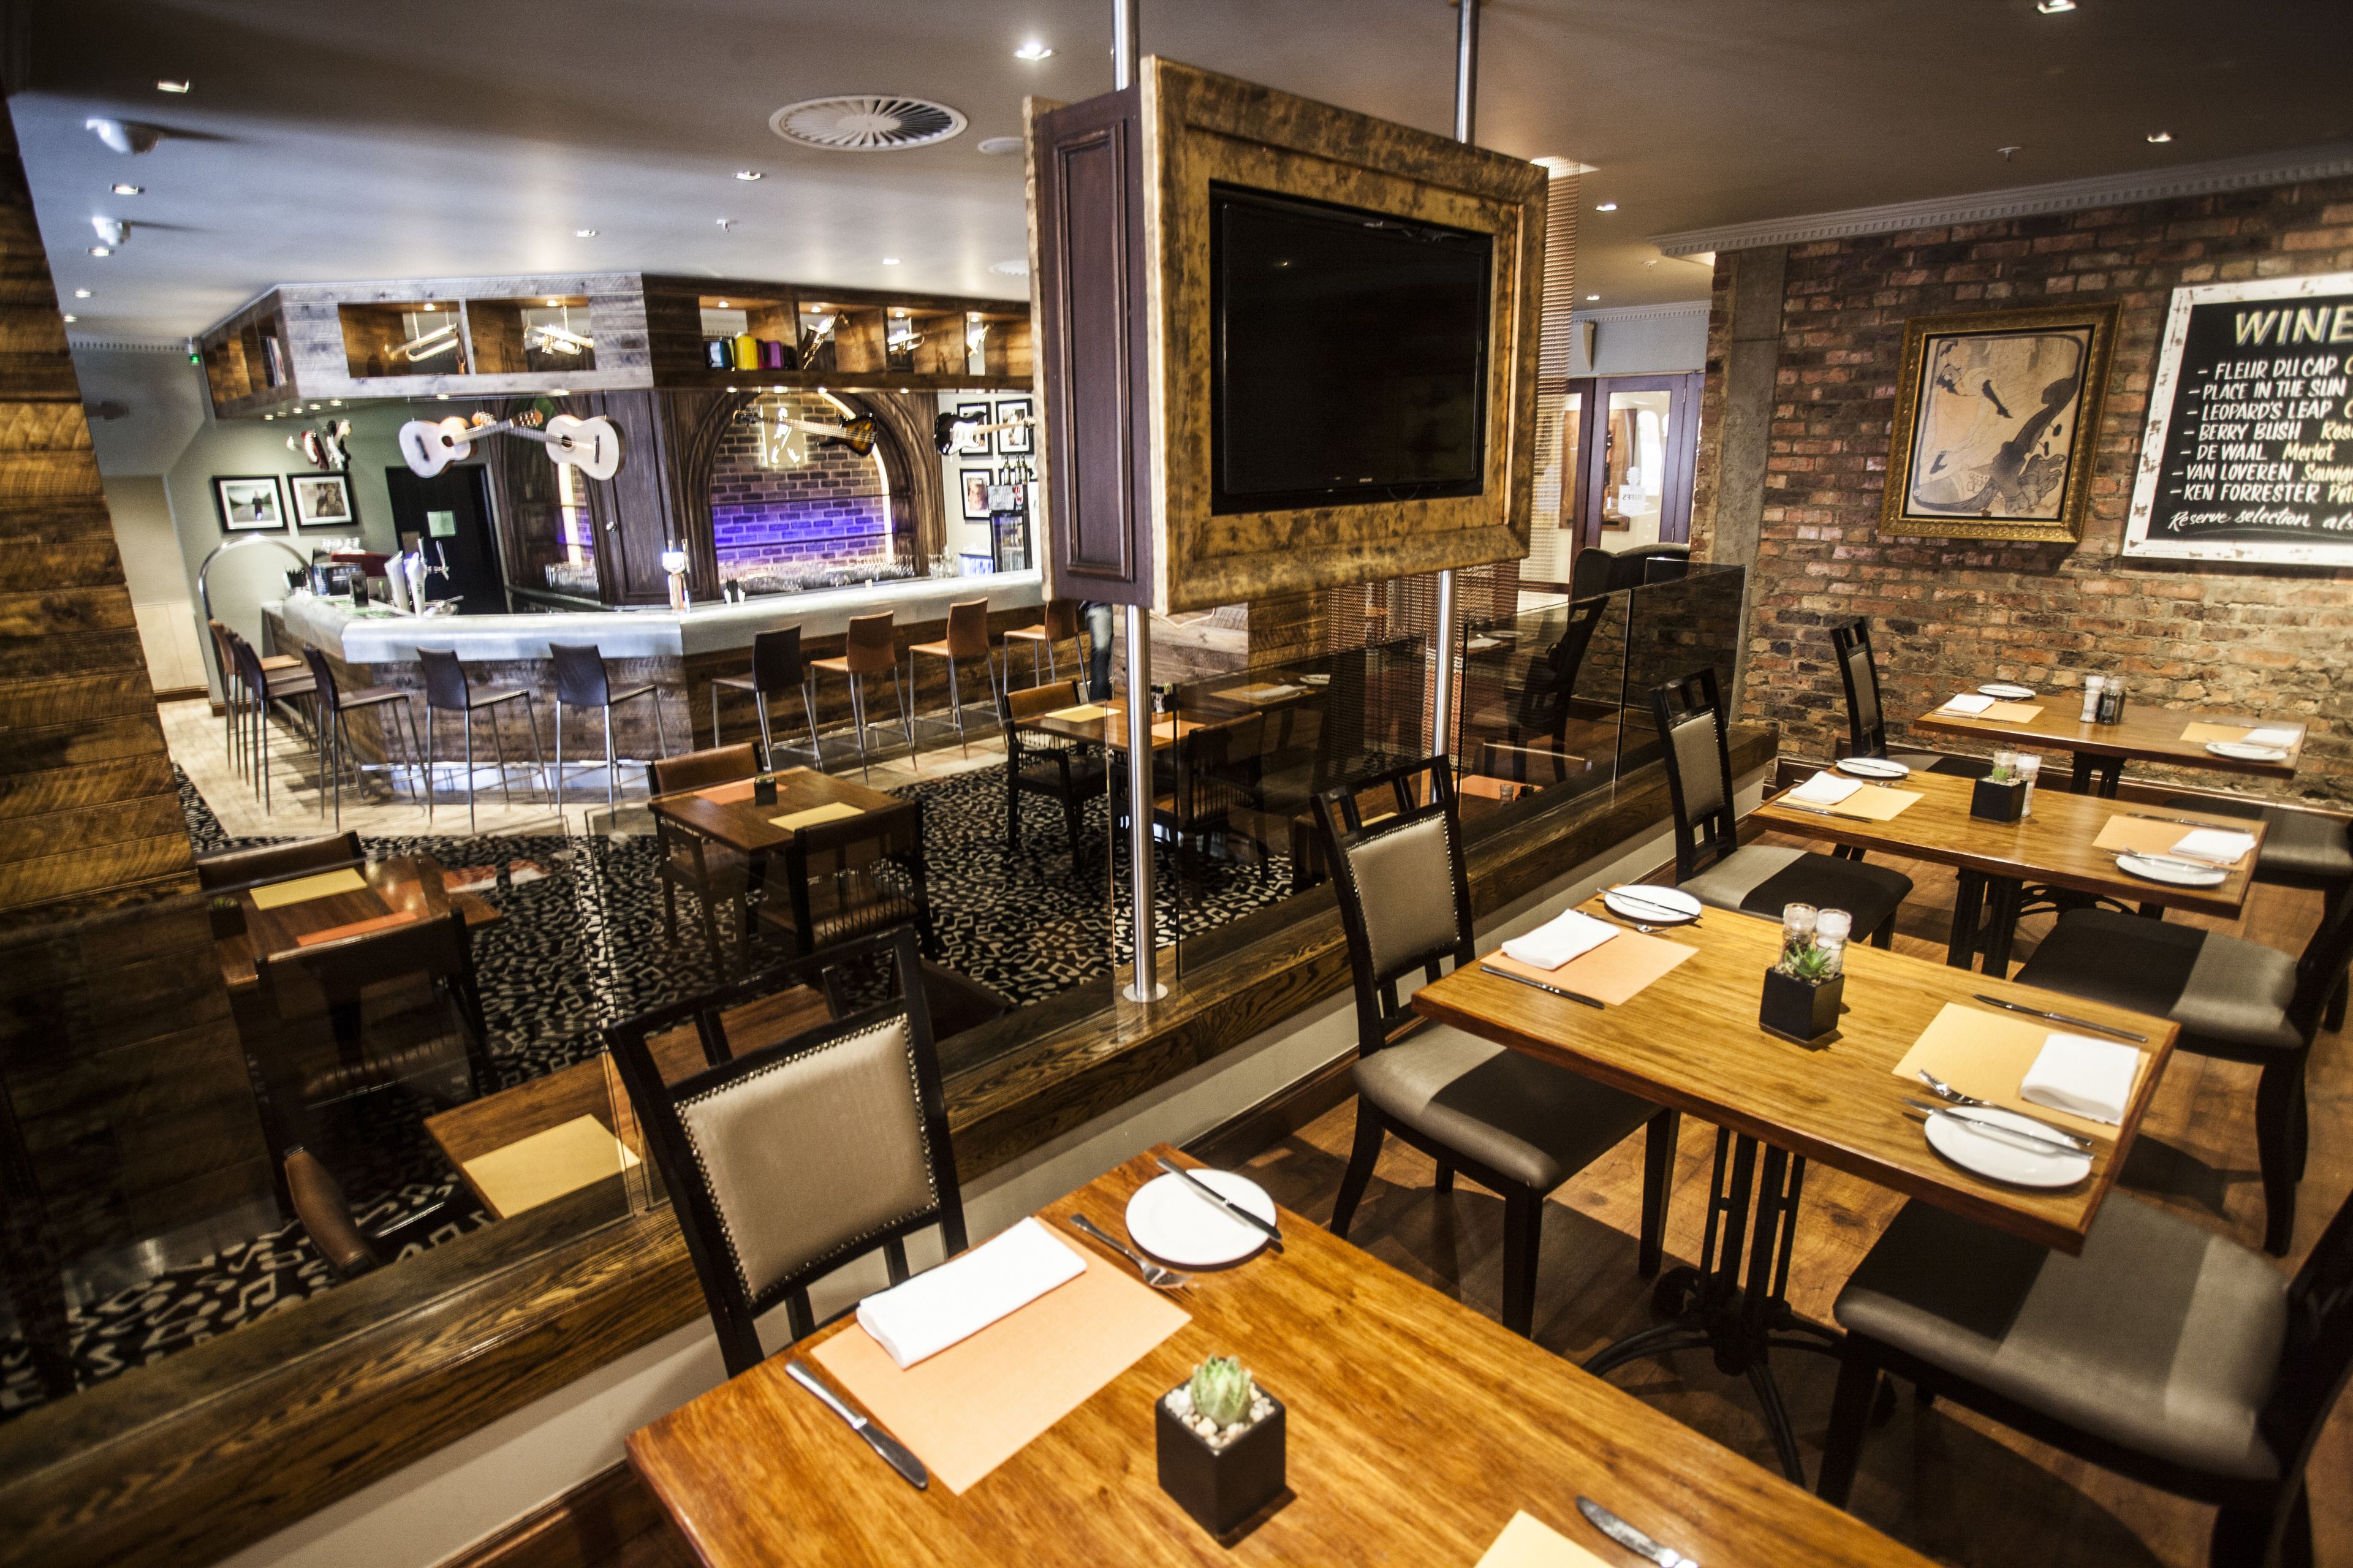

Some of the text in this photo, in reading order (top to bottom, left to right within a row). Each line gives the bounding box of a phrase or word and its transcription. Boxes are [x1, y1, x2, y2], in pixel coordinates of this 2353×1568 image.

[2215, 358, 2268, 381] FLEUR
[2272, 357, 2300, 378] DU
[2301, 355, 2338, 377] CAP
[2203, 376, 2348, 400] PLACE IN THE SUN
[2202, 400, 2284, 422] LEOPARD'S
[2287, 399, 2333, 420] LEAP
[2198, 422, 2249, 441] BERRY
[2253, 420, 2302, 441] BUSH
[2197, 441, 2335, 461] DE WAAL Merlot
[2186, 462, 2216, 480] VAN
[2220, 461, 2294, 482] LOVEREN
[2183, 483, 2215, 501] KEN
[2220, 482, 2321, 504] FORRESTER
[2167, 510, 2232, 532] Reserve
[2234, 505, 2311, 528] selection
